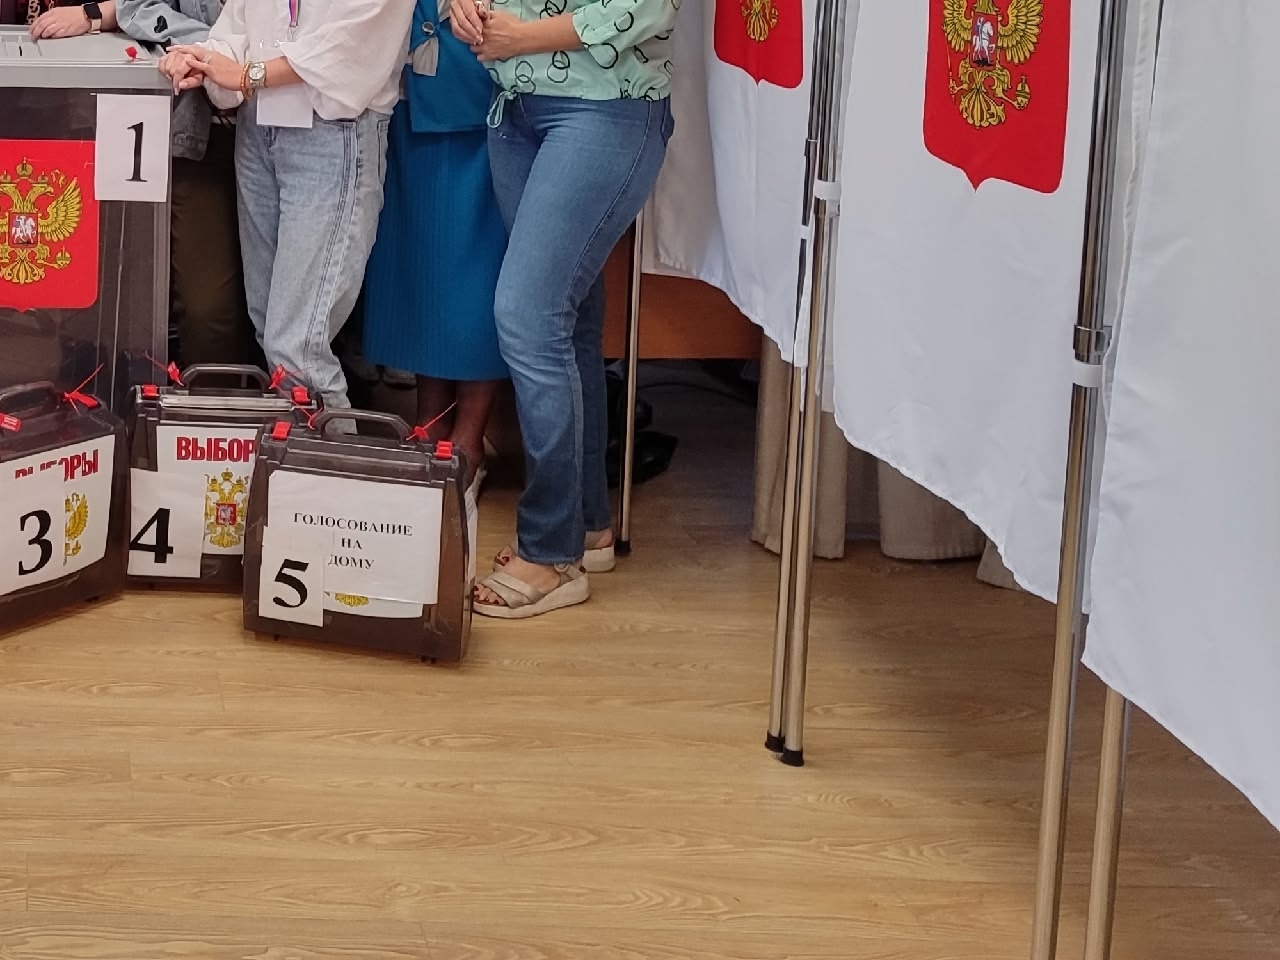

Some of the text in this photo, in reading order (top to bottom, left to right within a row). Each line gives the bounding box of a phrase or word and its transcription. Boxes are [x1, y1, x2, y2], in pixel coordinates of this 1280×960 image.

[125, 121, 147, 182] 1
[176, 436, 256, 463] ВЫБОР
[17, 509, 54, 577] 3
[128, 506, 174, 565] 4
[293, 512, 414, 537] ГОЛОСОВАНИЕ
[340, 536, 363, 550] НА
[327, 553, 375, 570] ДОМУ
[271, 557, 310, 609] 5
